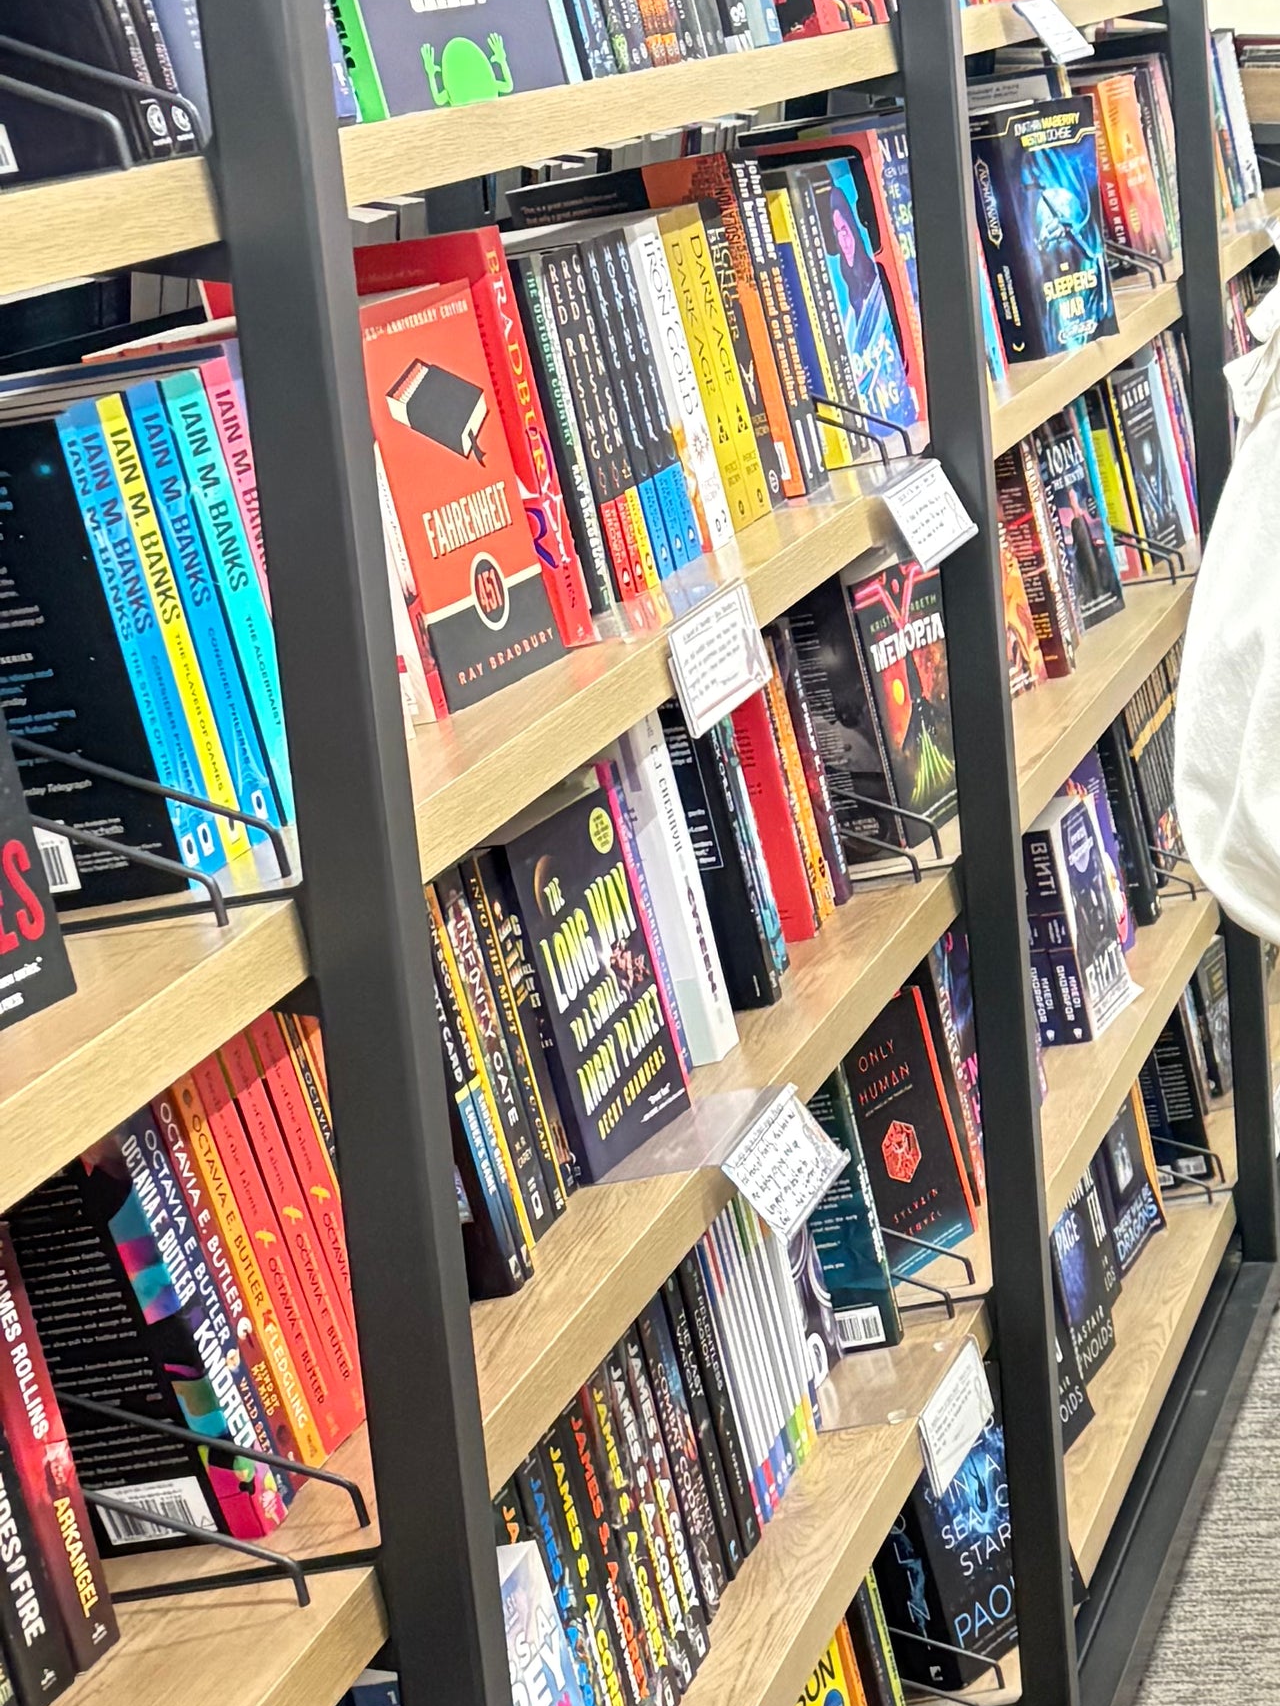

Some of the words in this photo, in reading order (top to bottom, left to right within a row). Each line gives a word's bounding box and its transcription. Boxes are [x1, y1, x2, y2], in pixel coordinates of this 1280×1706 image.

[772, 267, 790, 312] stand
[788, 336, 808, 400] zanzibar
[179, 401, 212, 457] IAIN
[197, 462, 221, 498] M.
[421, 480, 514, 559] FAHRENHEIT
[208, 500, 249, 592] BANKS
[474, 568, 501, 614] 451
[458, 659, 488, 685] RAY
[489, 627, 554, 677] BRADBURY
[544, 877, 565, 916] THE
[540, 907, 600, 1014] LONG
[585, 862, 637, 945] WAY
[456, 920, 497, 1038] INFINITY
[494, 1050, 520, 1127] GATE
[577, 1034, 621, 1116] ANGRY
[614, 984, 665, 1069] PLANET
[858, 1038, 895, 1075] ONLY
[858, 1062, 910, 1106] HUMAN
[10, 1342, 49, 1440] ROLLINS
[54, 1495, 101, 1618] ARKANGEL
[942, 1506, 982, 1550] SEA
[10, 1568, 46, 1647] FIRE
